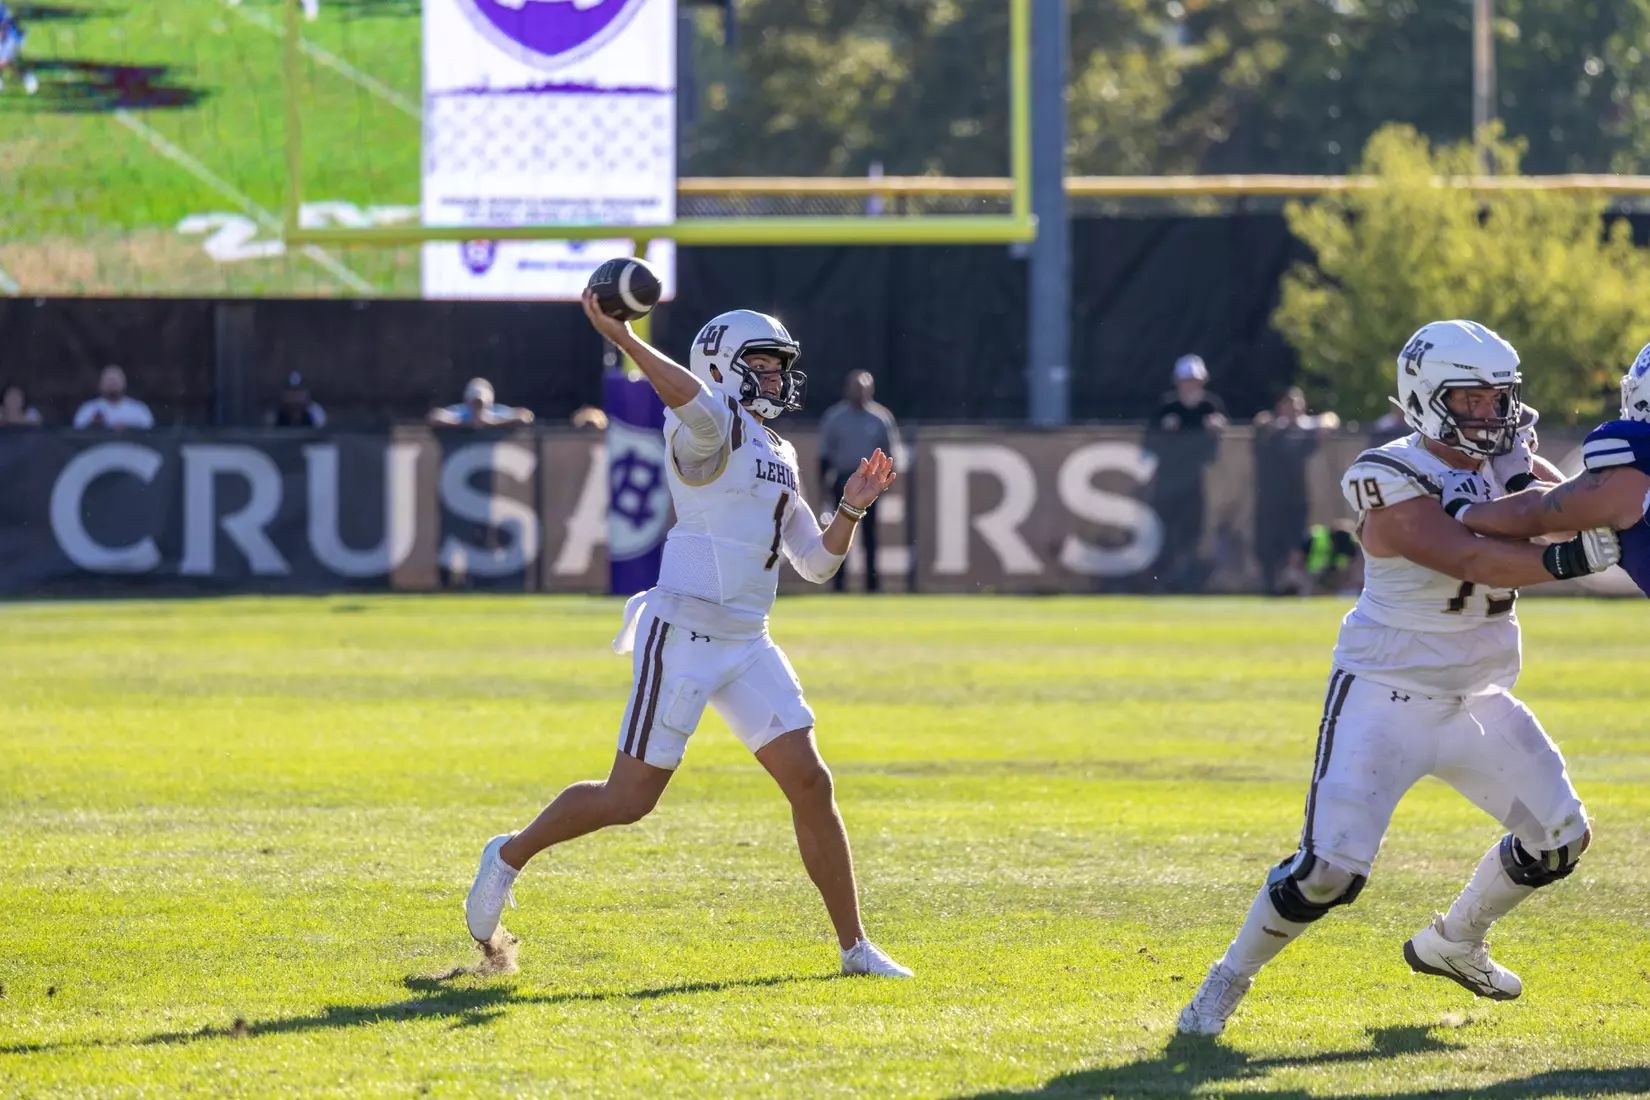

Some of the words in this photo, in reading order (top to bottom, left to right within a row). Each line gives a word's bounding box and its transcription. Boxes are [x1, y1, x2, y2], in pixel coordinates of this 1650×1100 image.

[755, 458, 797, 491] LEHIG
[1349, 477, 1385, 510] 79
[50, 441, 1164, 578] CRUSARS
[764, 490, 789, 571] 1
